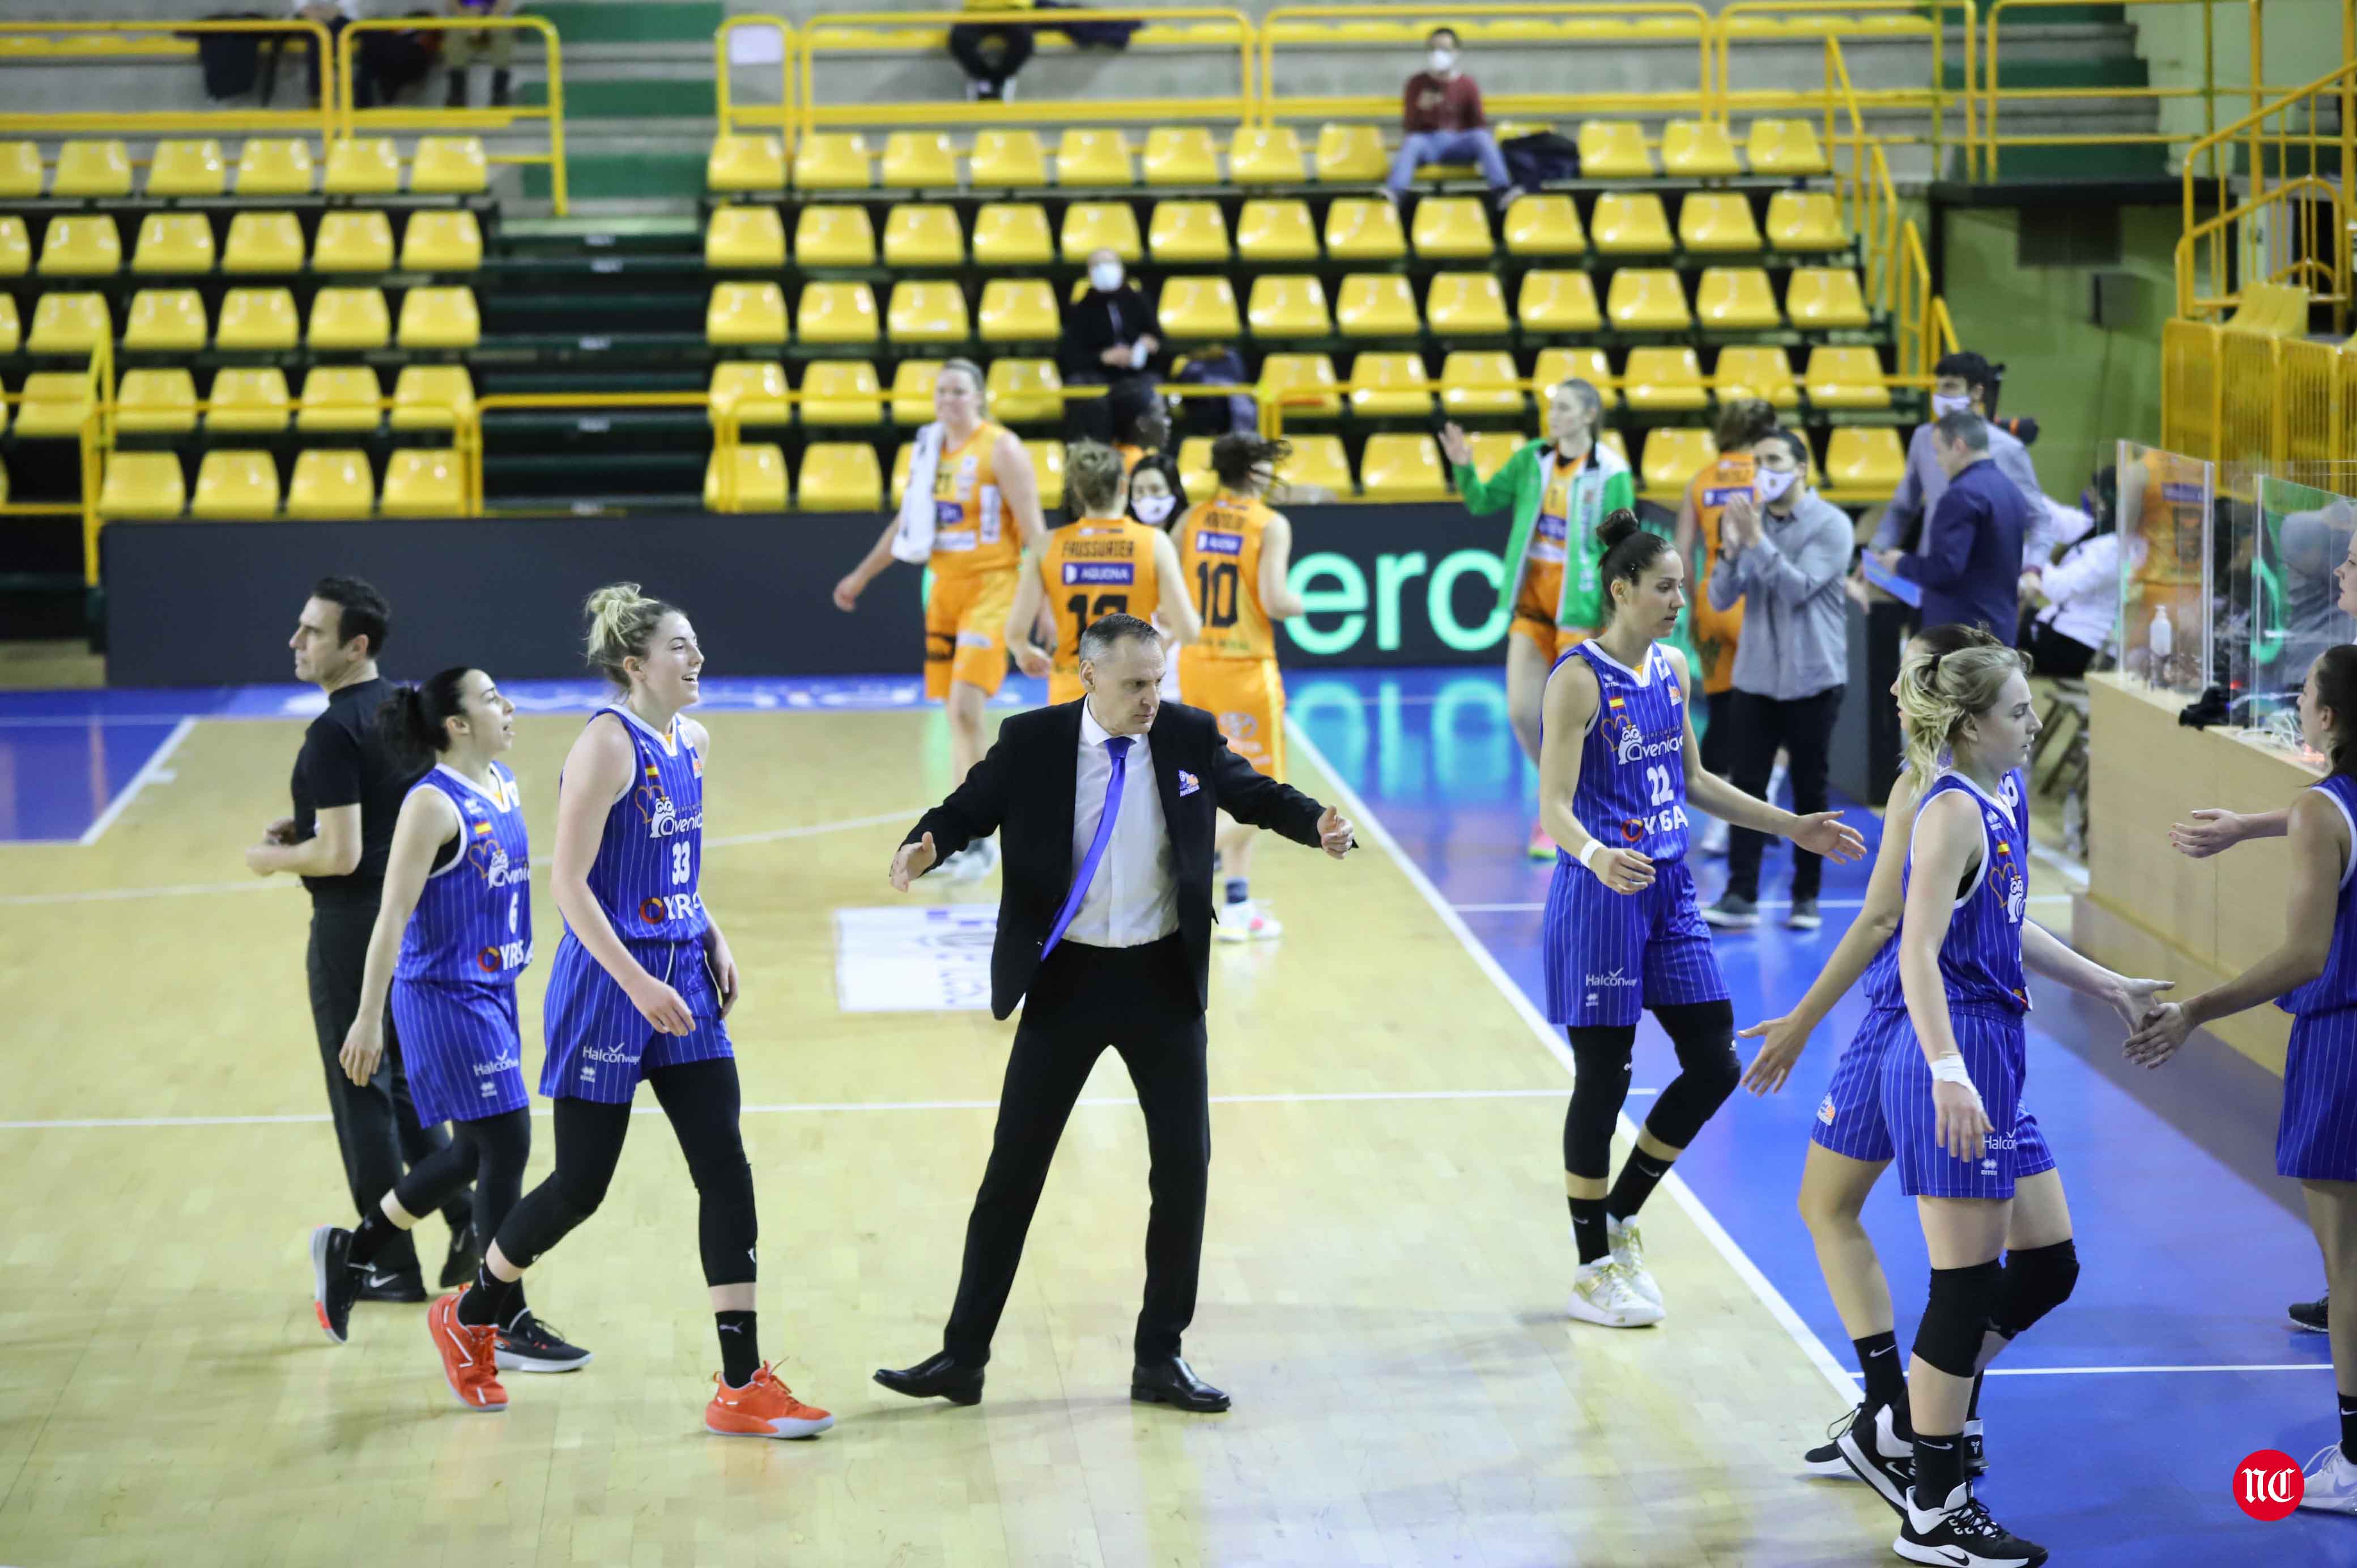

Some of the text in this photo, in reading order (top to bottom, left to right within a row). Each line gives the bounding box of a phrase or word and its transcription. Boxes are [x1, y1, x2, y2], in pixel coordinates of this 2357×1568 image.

[1197, 561, 1238, 628] 10
[1646, 764, 1674, 807] 22
[672, 840, 691, 886] 33
[508, 892, 519, 935] 6
